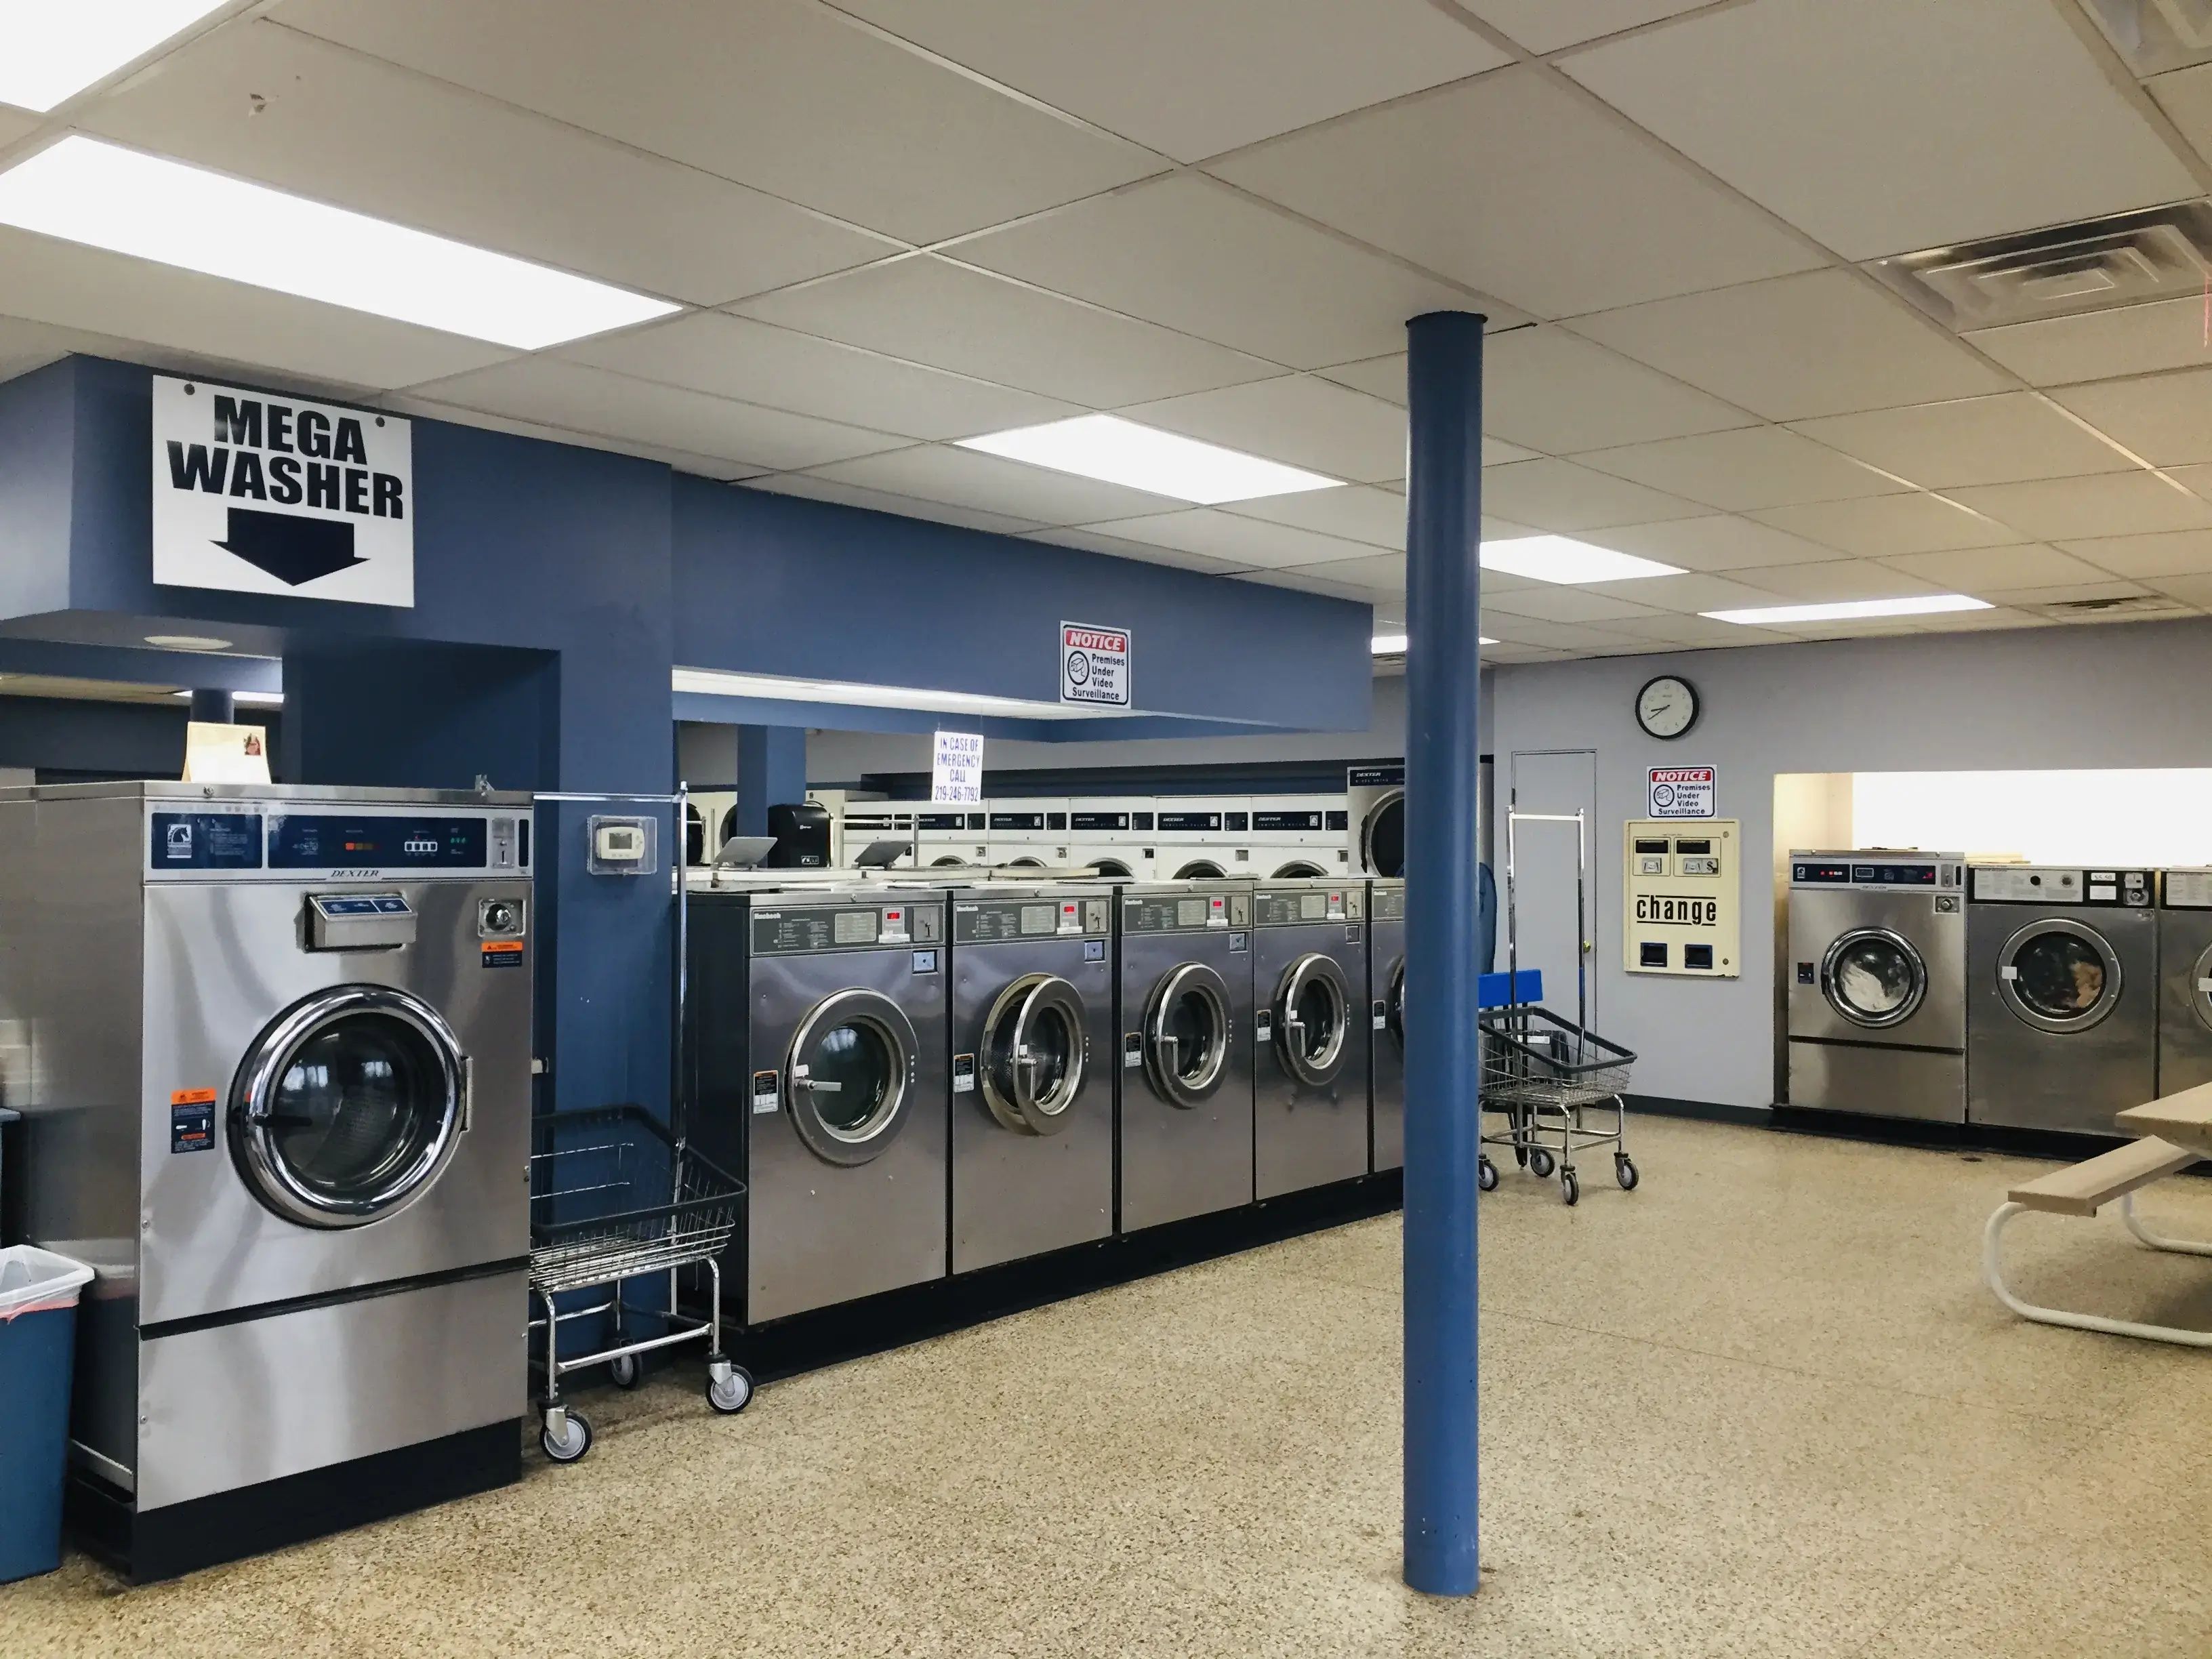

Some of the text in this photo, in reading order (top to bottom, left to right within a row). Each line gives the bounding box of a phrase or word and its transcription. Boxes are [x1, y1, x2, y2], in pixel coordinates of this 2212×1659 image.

[214, 394, 367, 465] MEGA
[167, 440, 403, 519] WASHER
[1069, 632, 1122, 651] NOTICE
[1092, 653, 1125, 666] Premises
[1092, 665, 1114, 676] Under
[1092, 677, 1113, 688] Video
[1072, 687, 1119, 700] Surveillance
[940, 737, 979, 752] IN CASE OF
[937, 753, 980, 767] EMERGENCY
[949, 769, 966, 782] CALL
[1656, 771, 1707, 781] NOTICE
[935, 785, 979, 802] 219-246-7792
[1636, 895, 1717, 925] change
